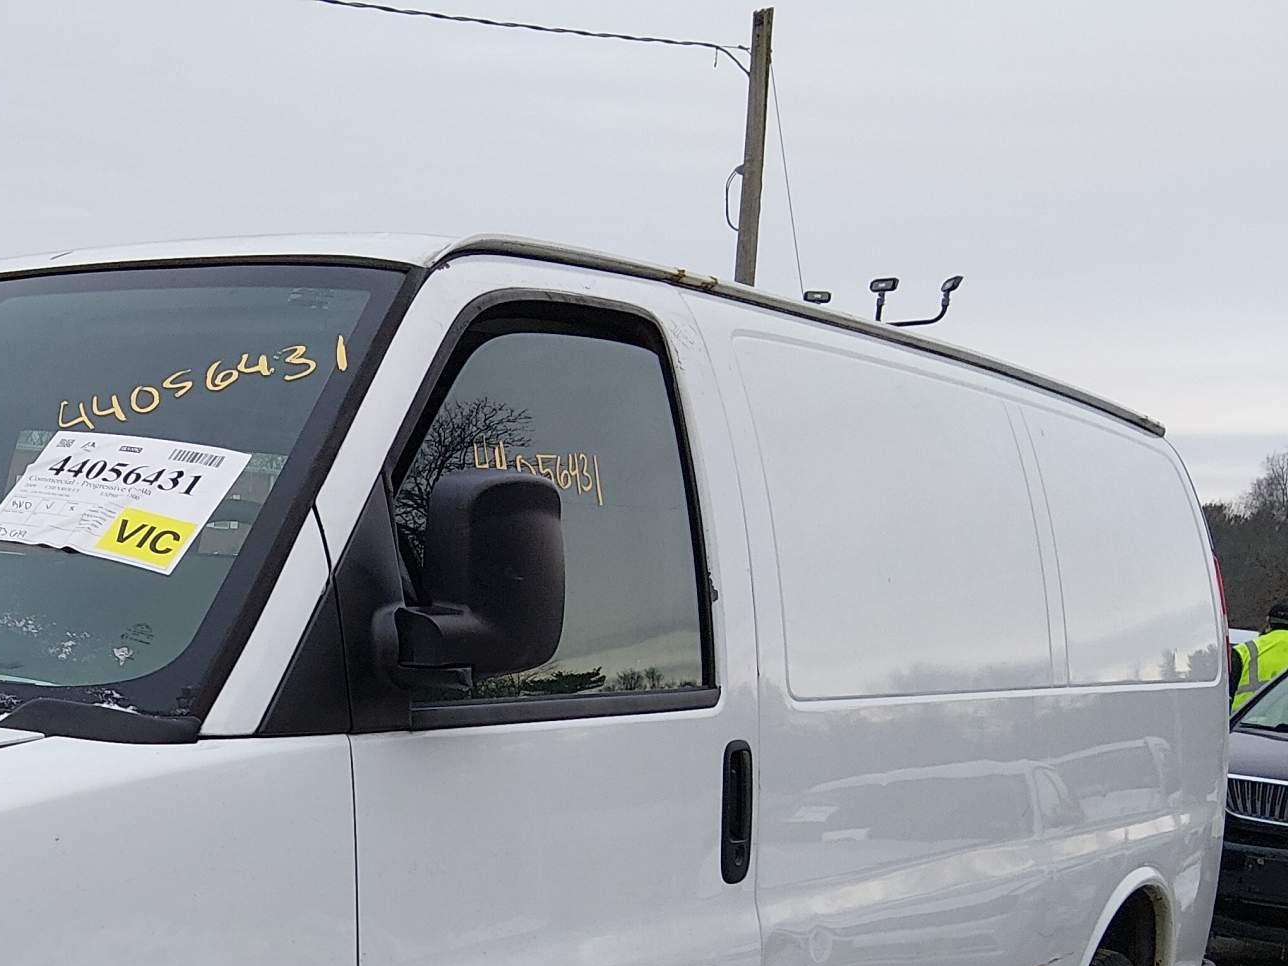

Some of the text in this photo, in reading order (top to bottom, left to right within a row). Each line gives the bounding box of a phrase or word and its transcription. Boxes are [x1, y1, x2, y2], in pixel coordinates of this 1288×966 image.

[58, 335, 349, 430] 44056431
[48, 455, 202, 496] 44056431
[116, 518, 181, 555] VIC
